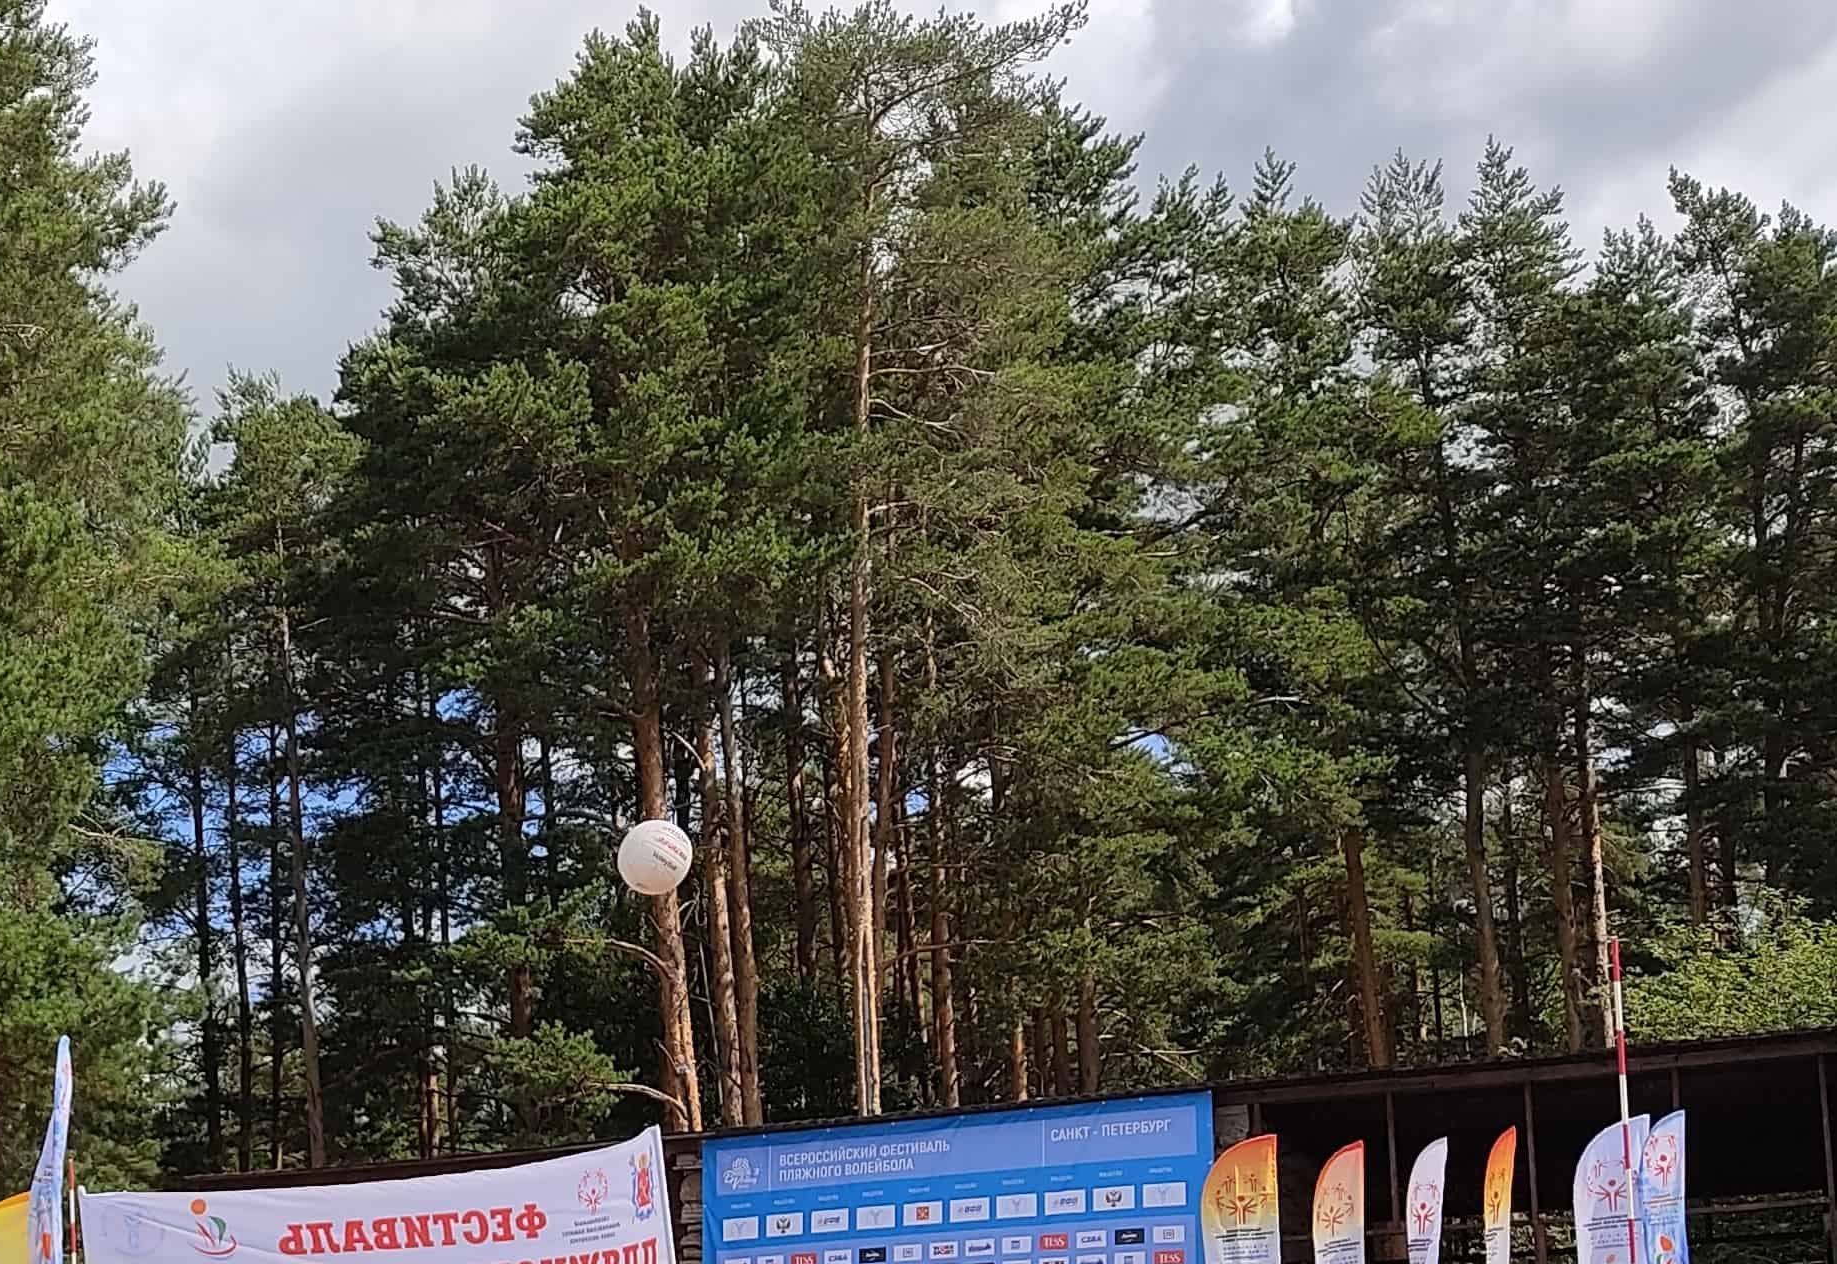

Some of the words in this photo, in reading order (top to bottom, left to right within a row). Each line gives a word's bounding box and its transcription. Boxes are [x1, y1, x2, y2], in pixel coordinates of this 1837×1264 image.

[1050, 1127, 1090, 1142] САНКТ
[1101, 1118, 1172, 1137] ПЕТЕРБУРГ
[779, 1143, 877, 1167] ВСЕРОССИЙСКИЙ
[879, 1139, 950, 1157] ФЕСТИВАЛЬ
[779, 1165, 842, 1182] ПЛЯЖНОГО
[845, 1159, 914, 1177] ВОЛЕЙБОЛА
